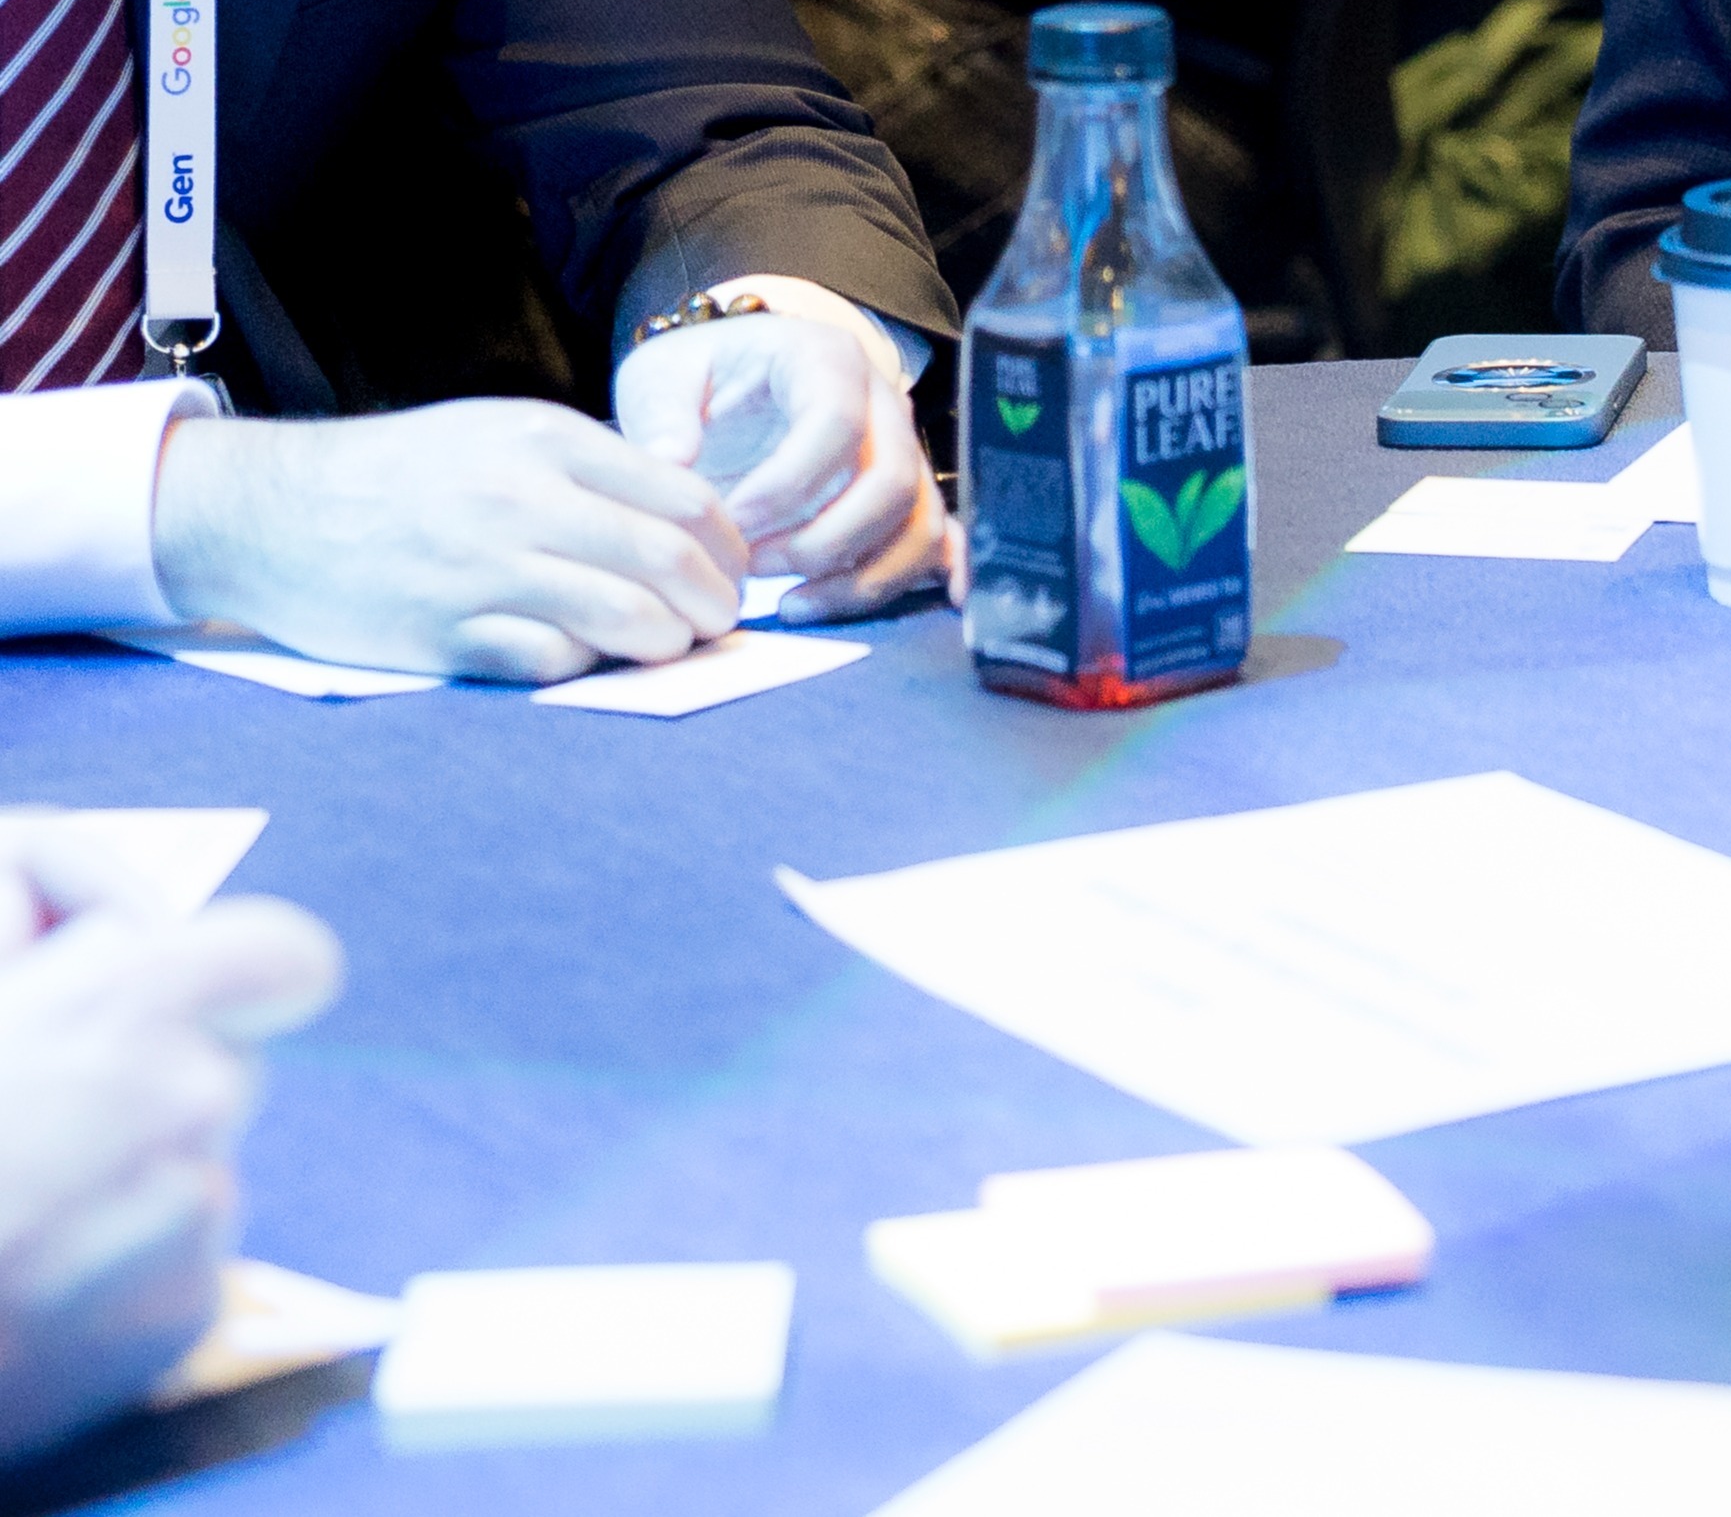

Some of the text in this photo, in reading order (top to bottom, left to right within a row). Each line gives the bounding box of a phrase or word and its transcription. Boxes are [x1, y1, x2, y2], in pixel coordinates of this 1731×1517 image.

[164, 154, 194, 224] Gen
[1135, 365, 1240, 422] PURE
[1136, 407, 1237, 465] LEAF
